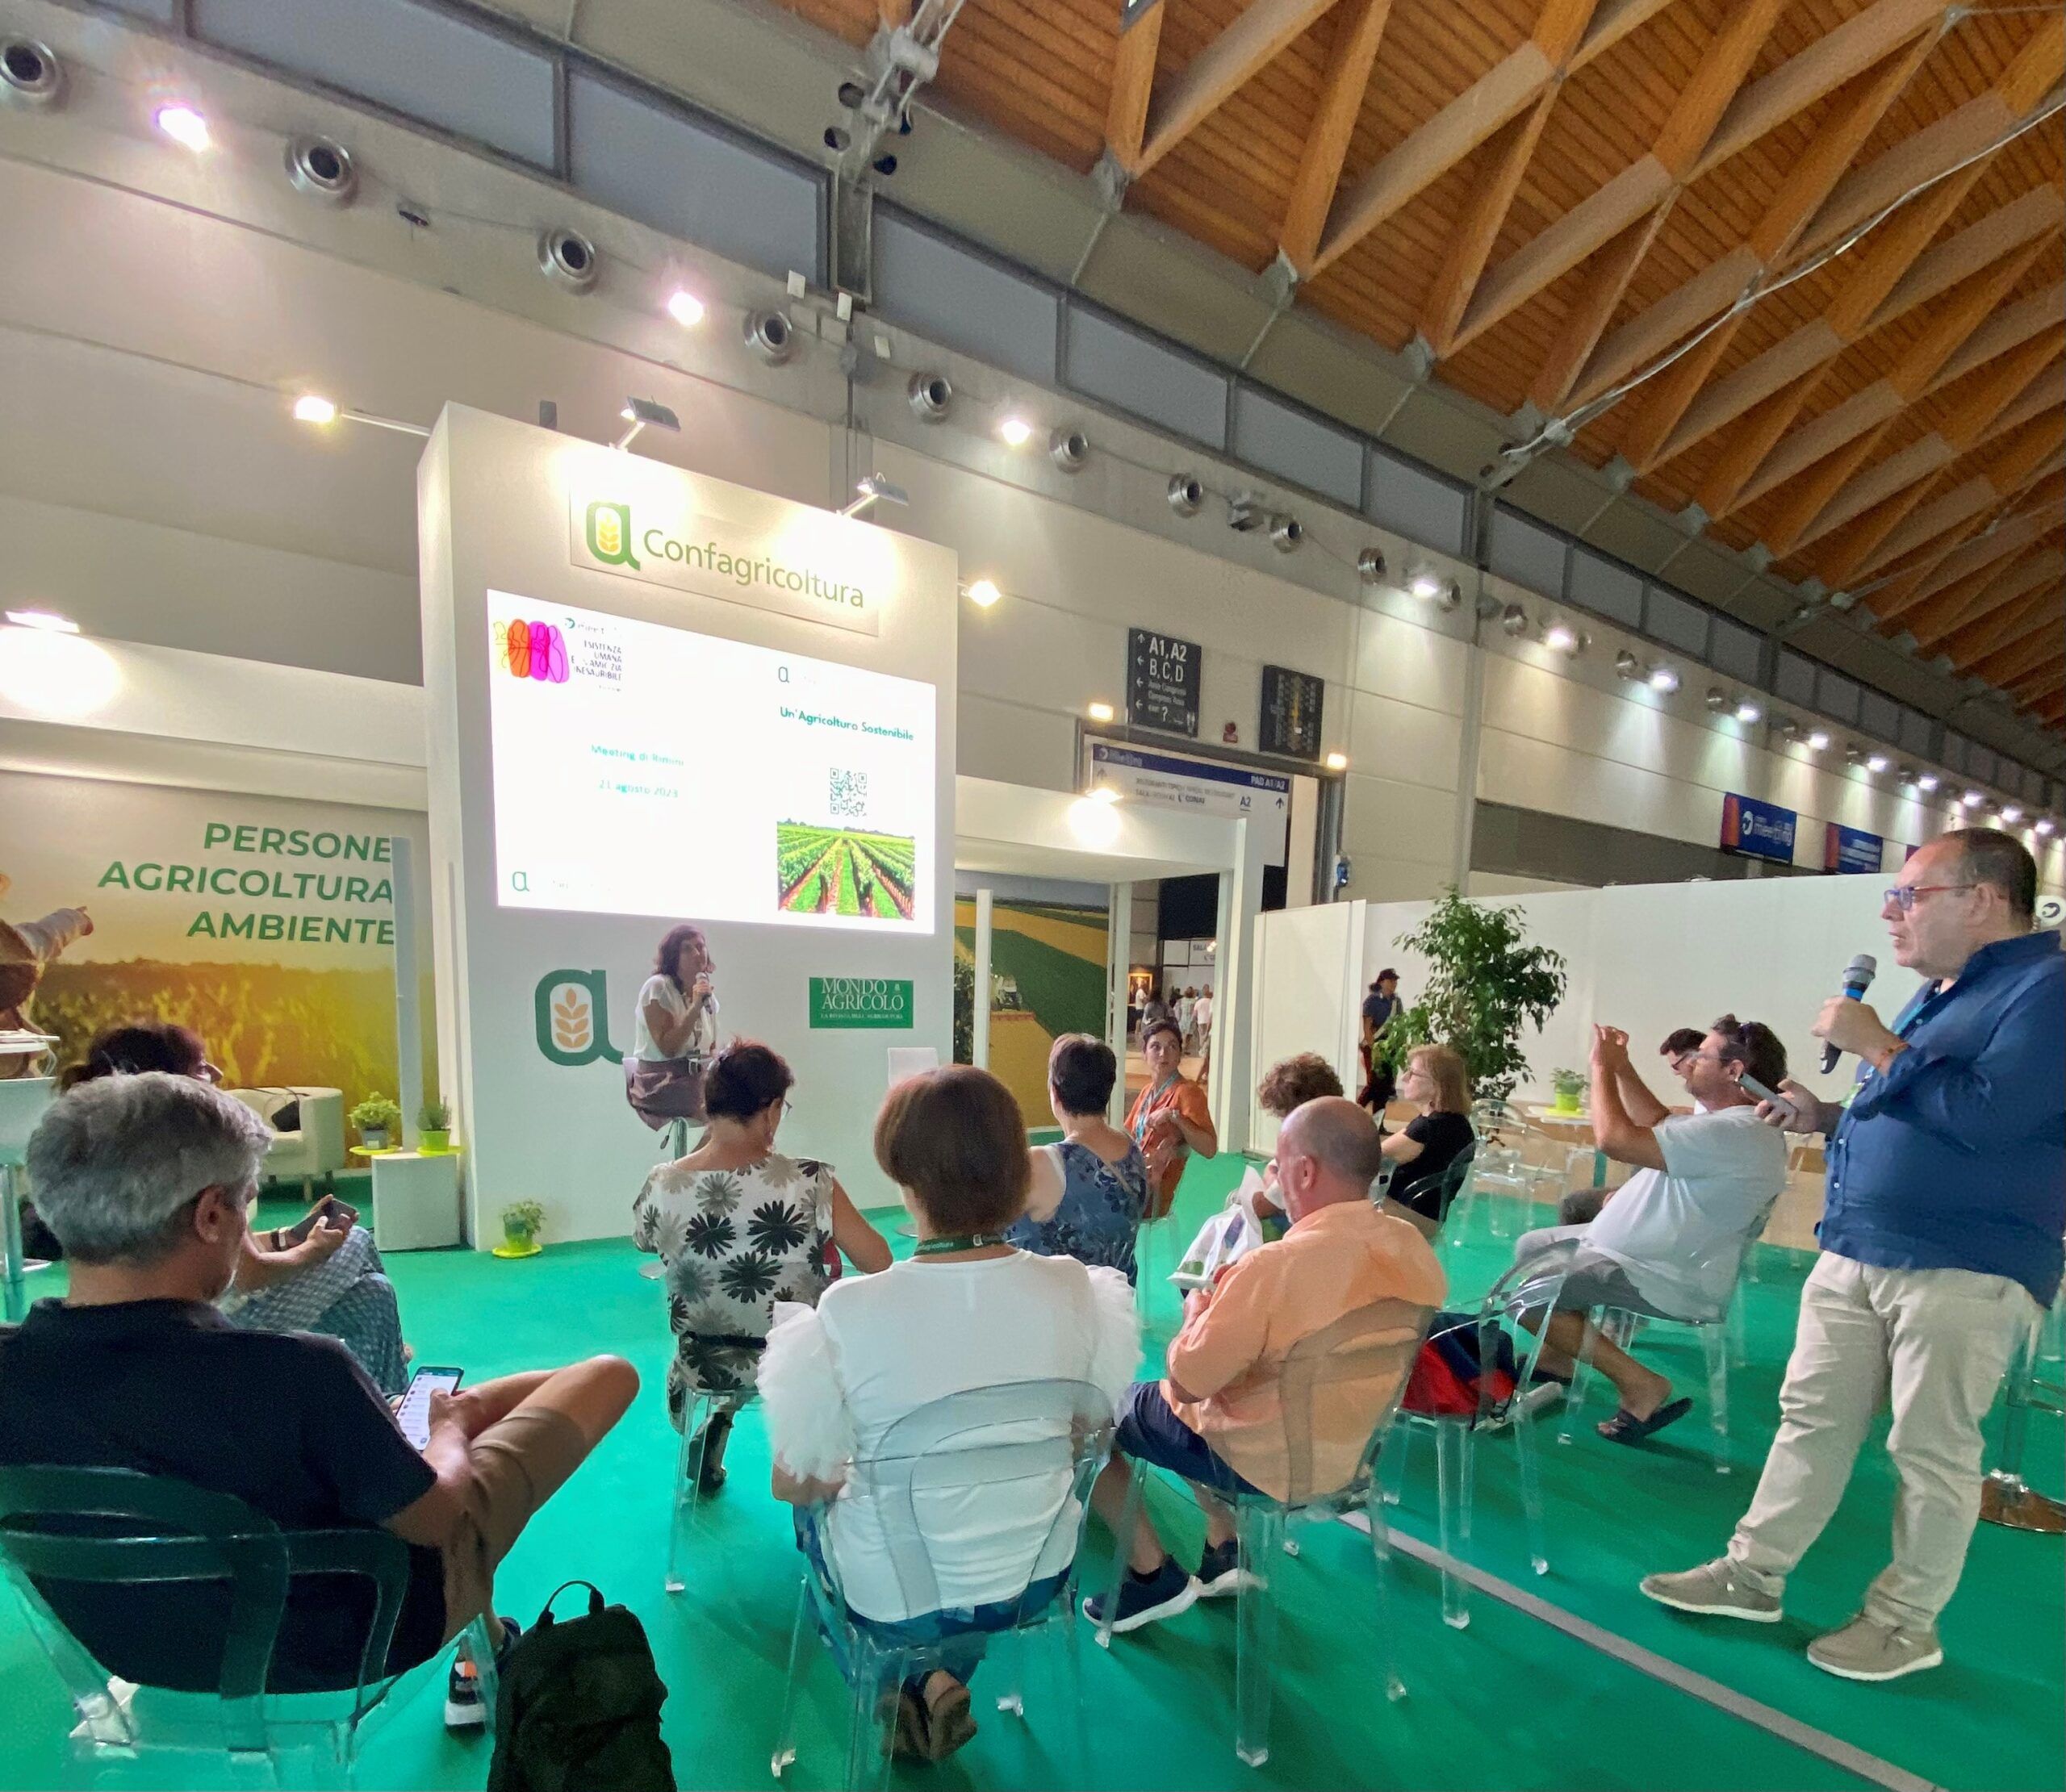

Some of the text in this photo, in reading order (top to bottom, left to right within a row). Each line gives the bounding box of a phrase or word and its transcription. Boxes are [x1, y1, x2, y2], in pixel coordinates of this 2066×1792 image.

[643, 528, 864, 608] Confagricoltura
[1170, 642, 1188, 662] A2
[1175, 664, 1184, 683] D
[861, 721, 914, 741] Sostenibile
[1239, 796, 1252, 808] A2
[204, 821, 391, 863] PERSONE
[98, 859, 393, 904] AGRICOLTURA
[186, 910, 395, 946] AMBIENTE
[821, 977, 888, 996] MONDO
[822, 993, 905, 1011] AGRICOLO
